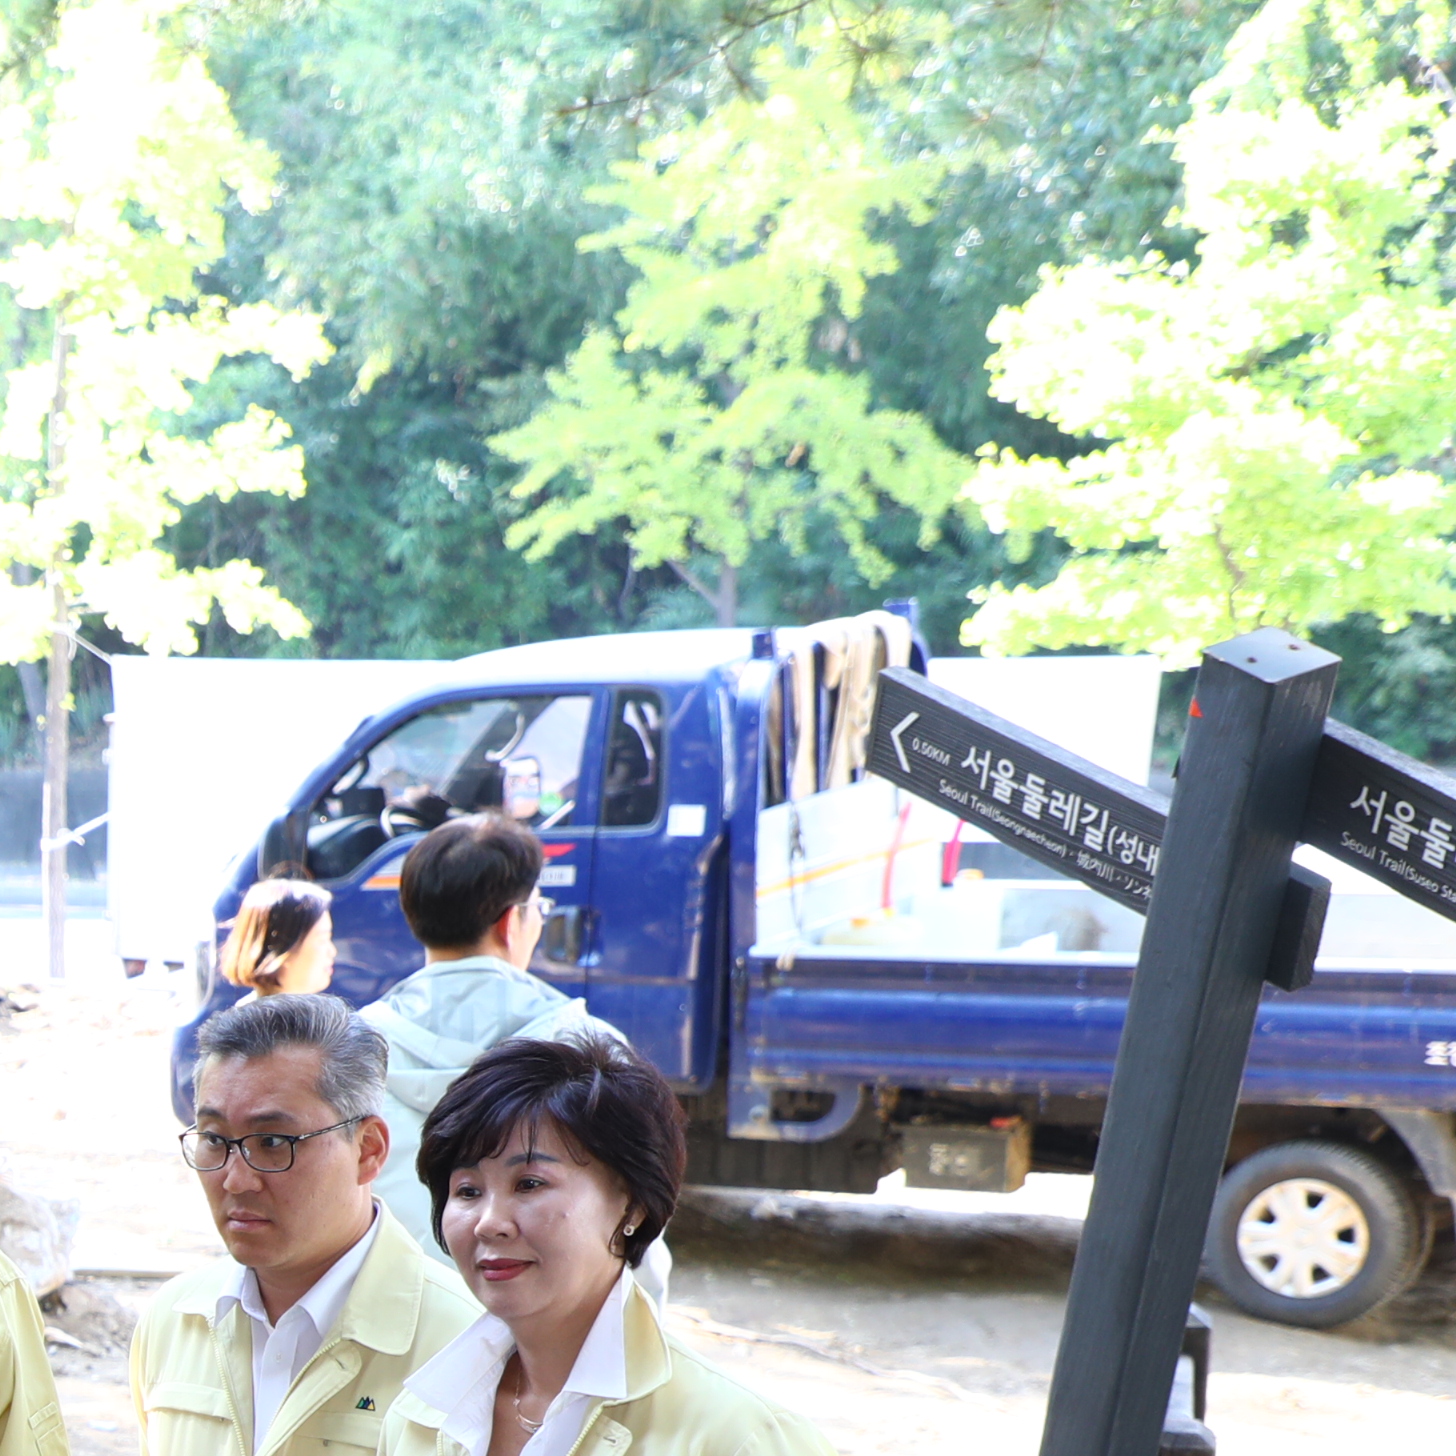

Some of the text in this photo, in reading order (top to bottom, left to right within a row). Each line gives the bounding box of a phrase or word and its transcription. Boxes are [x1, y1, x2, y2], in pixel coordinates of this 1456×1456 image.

[911, 736, 951, 766] 0.50KM
[938, 778, 968, 805] Seoul
[1350, 785, 1456, 870] 서울둘
[1340, 830, 1377, 860] Seoul
[1379, 850, 1439, 893] Trail(Suseo
